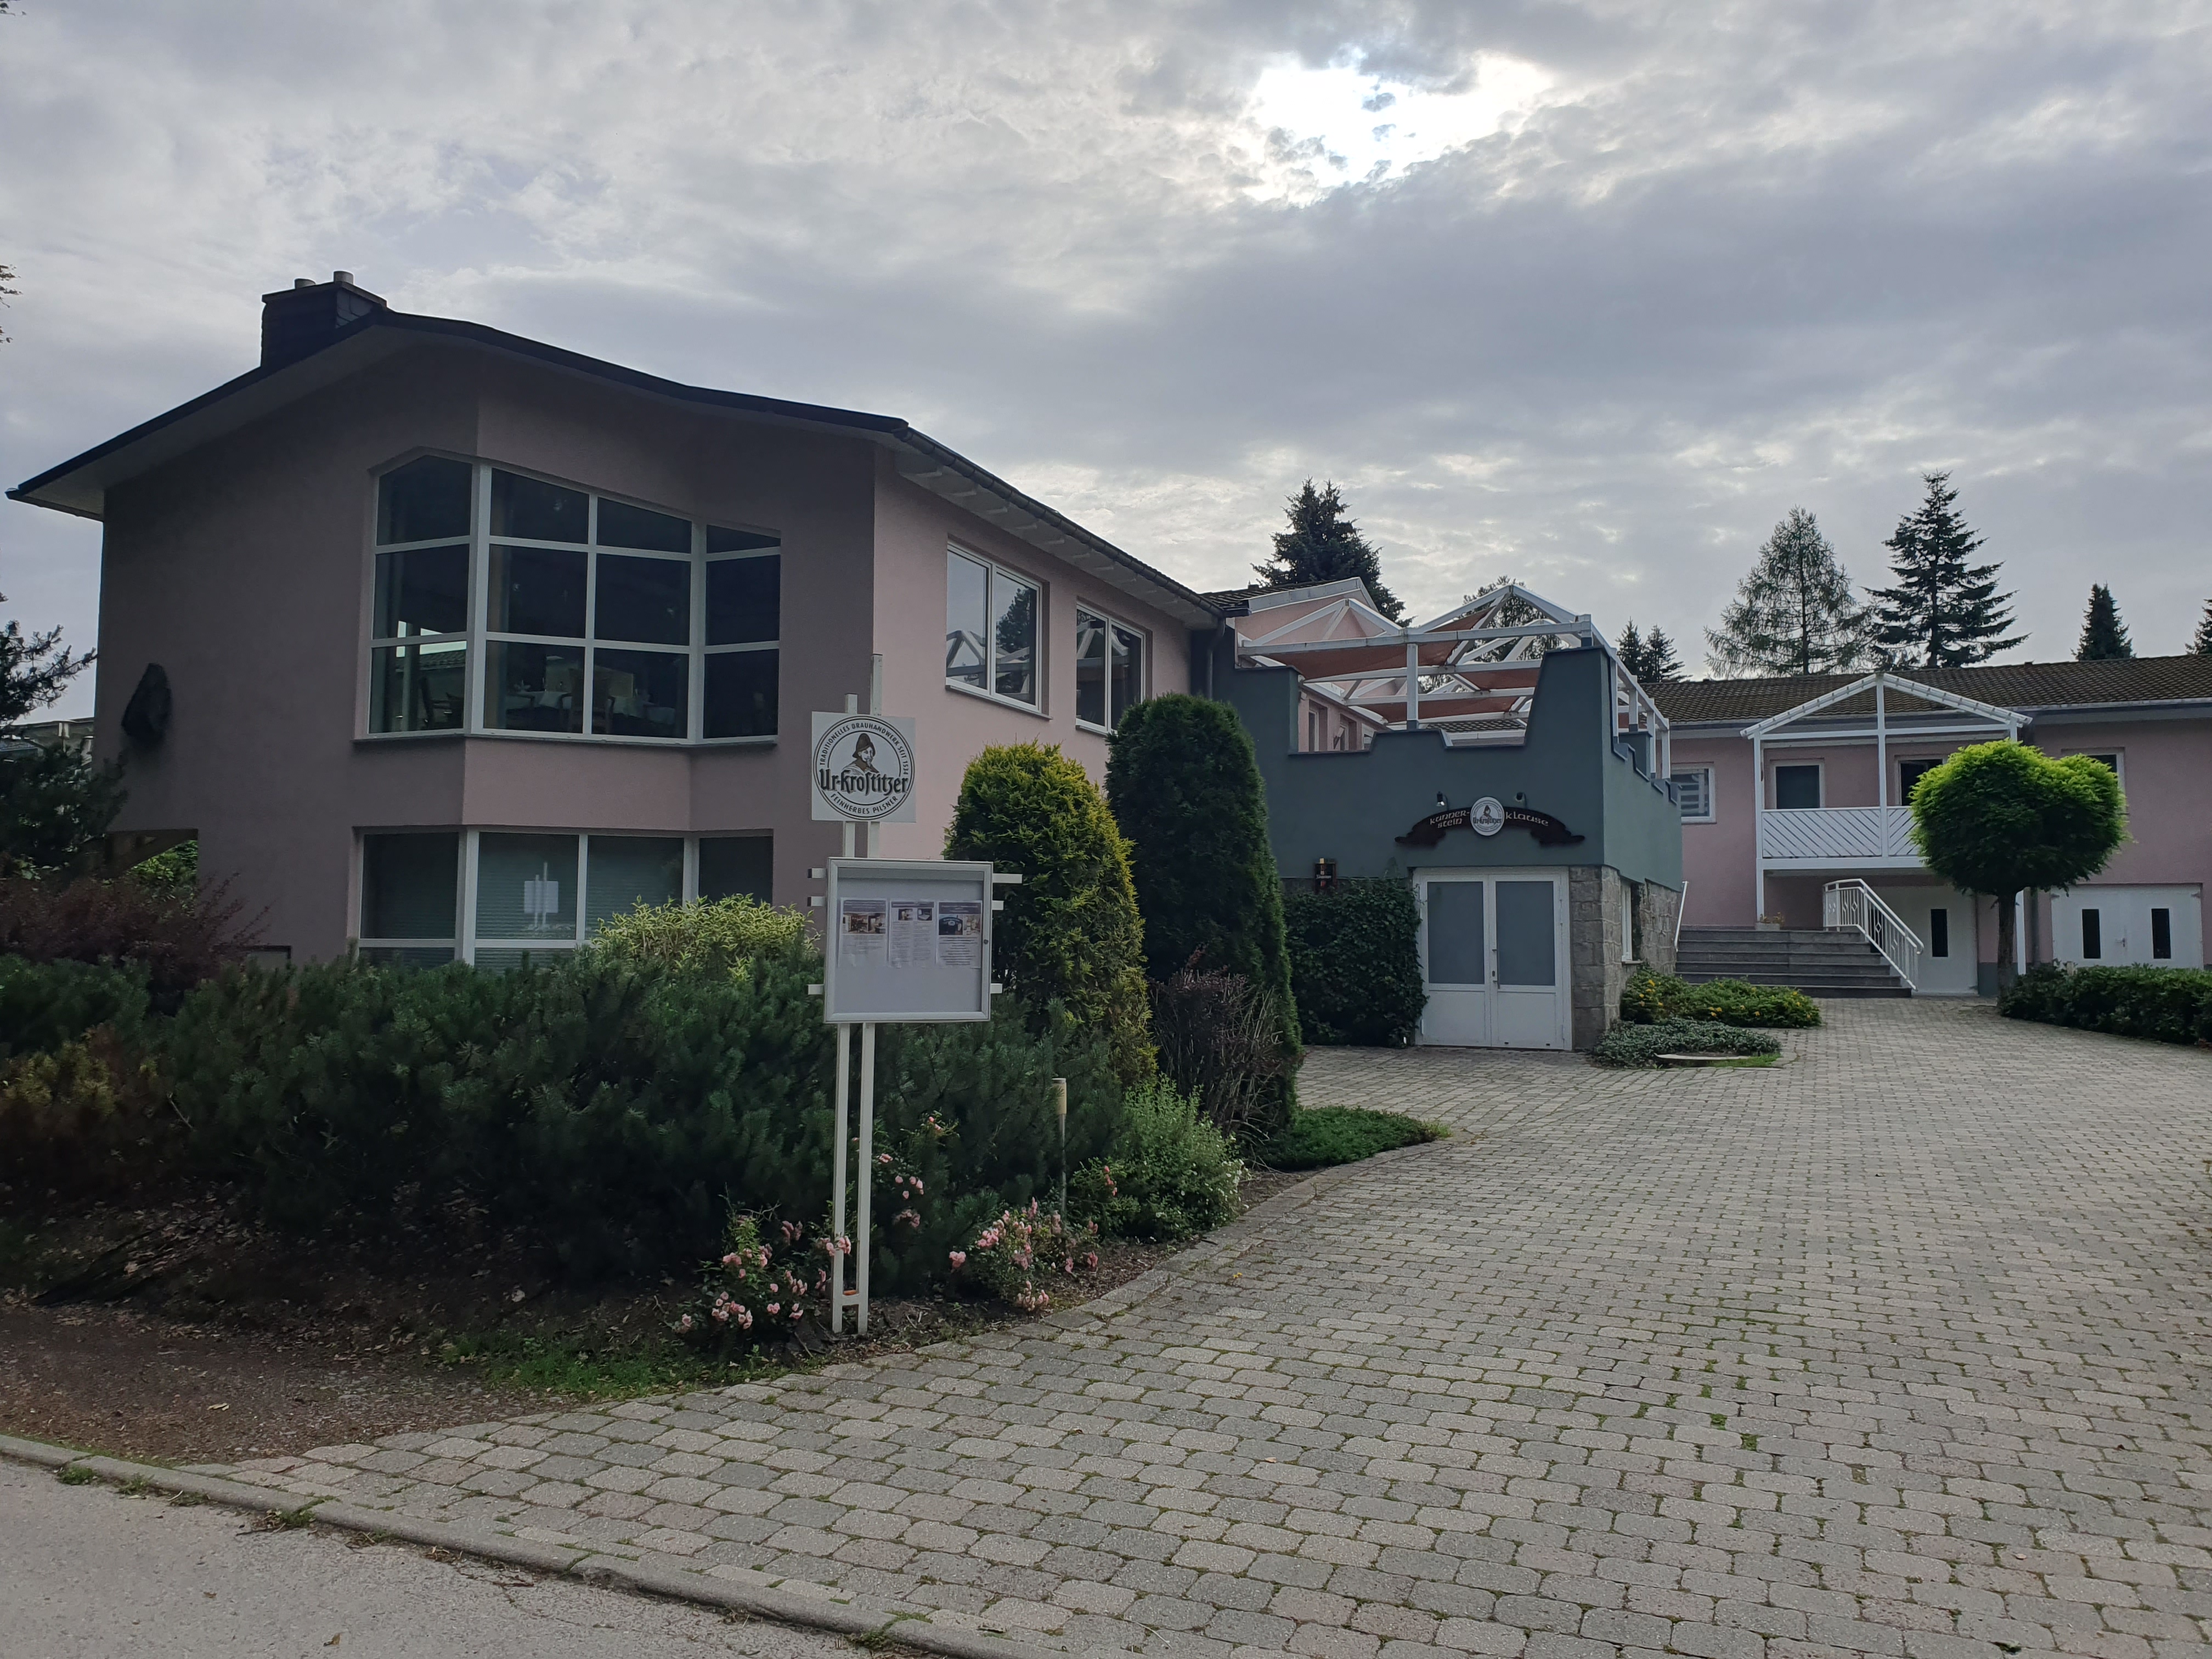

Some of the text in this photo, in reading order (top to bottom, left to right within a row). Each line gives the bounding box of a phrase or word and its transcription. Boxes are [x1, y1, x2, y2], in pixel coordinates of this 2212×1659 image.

[820, 725, 850, 765] TRADITIONELLES
[851, 722, 900, 747] BRAUHANDWERK
[898, 746, 907, 761] SEIT
[830, 793, 899, 814] FEINHERBES PILSNER
